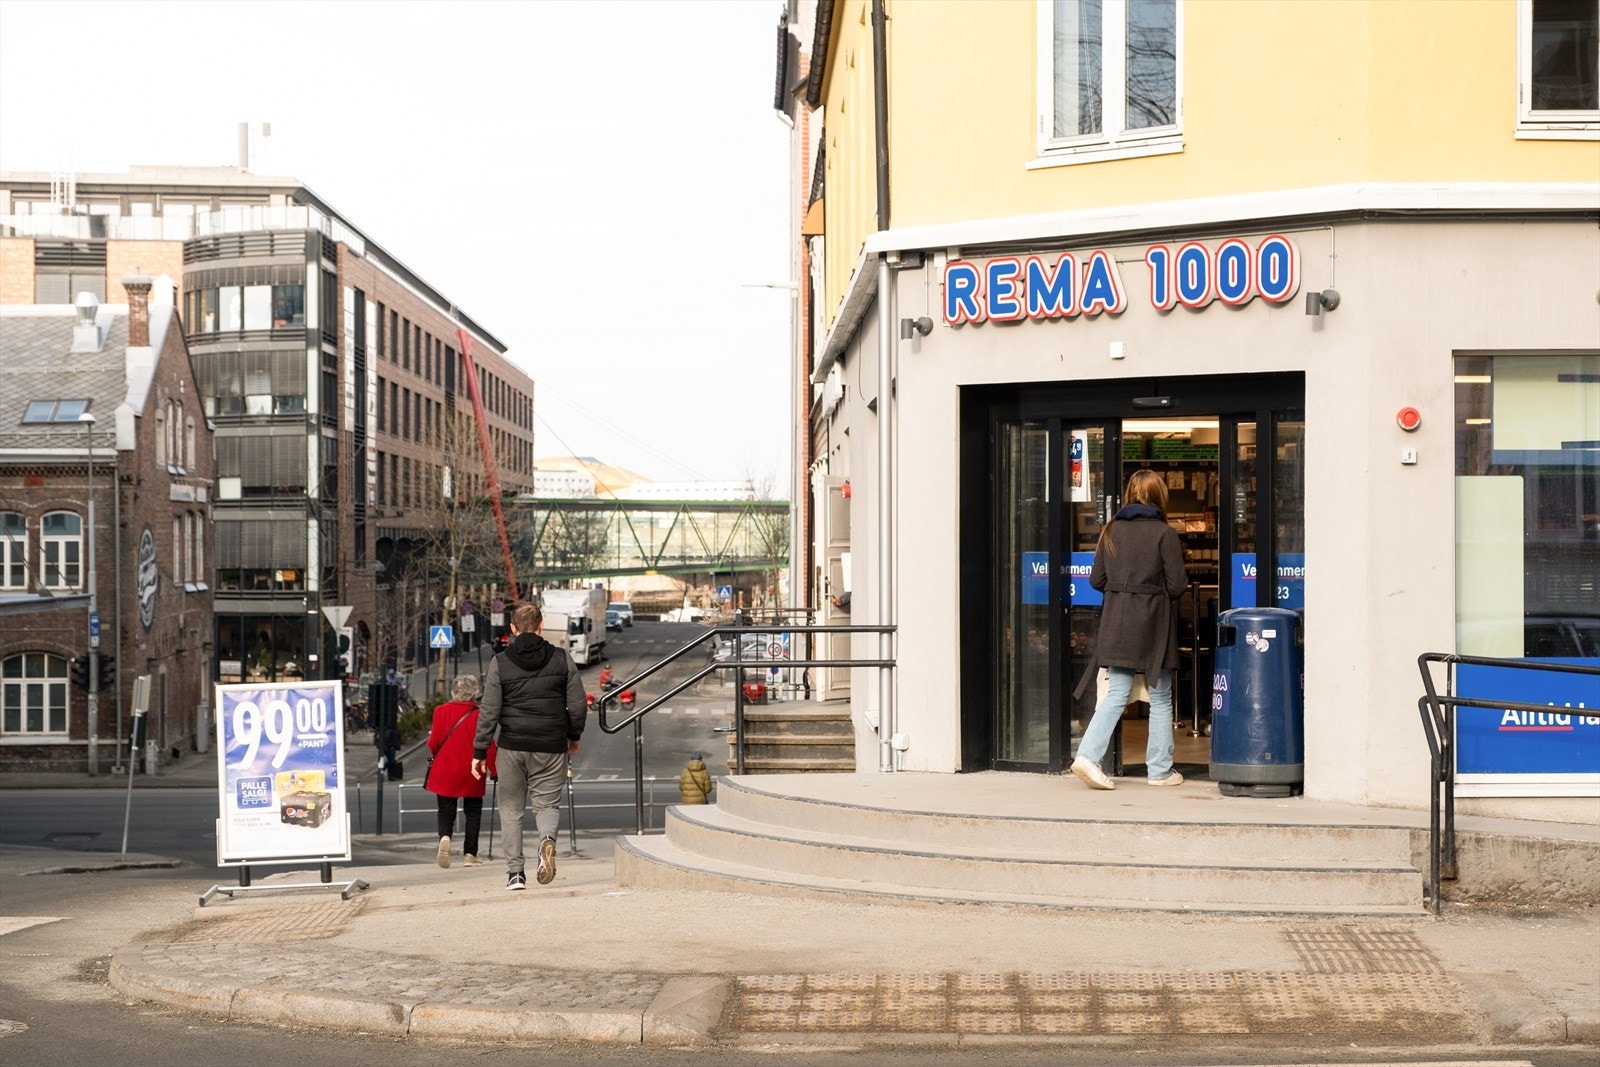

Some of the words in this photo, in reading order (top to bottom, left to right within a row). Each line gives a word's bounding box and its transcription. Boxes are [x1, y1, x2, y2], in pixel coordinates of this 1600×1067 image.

[944, 249, 1125, 324] REMA
[1145, 234, 1299, 310] 1000
[232, 700, 294, 770] 99
[296, 697, 327, 733] 00
[297, 740, 325, 748] +PANT
[241, 781, 267, 790] PALLE
[242, 789, 267, 798] SALG!
